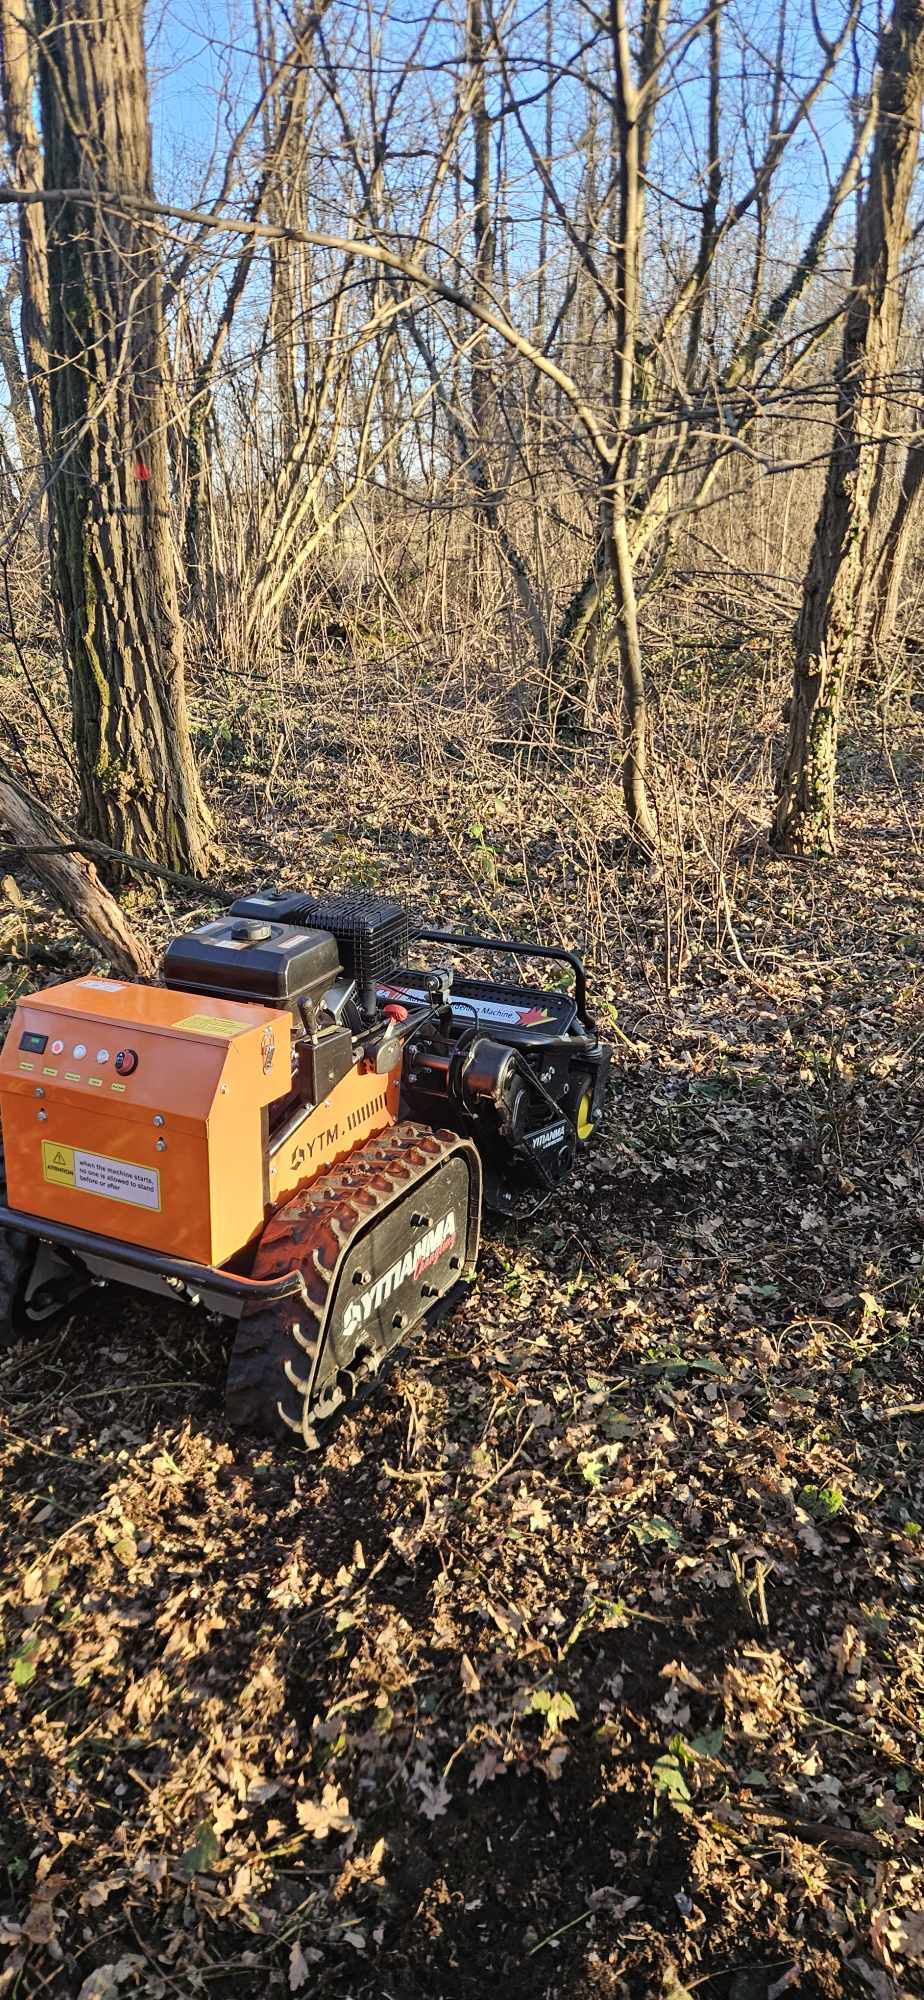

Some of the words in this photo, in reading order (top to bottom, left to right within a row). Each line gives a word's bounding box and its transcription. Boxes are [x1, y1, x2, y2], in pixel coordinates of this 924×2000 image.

[79, 1160, 95, 1169] when
[96, 1164, 106, 1173] the
[107, 1167, 133, 1179] machine
[79, 1175, 98, 1185] before
[106, 1182, 121, 1191] after
[88, 1170, 99, 1179] one
[107, 1175, 130, 1187] allowed
[137, 1184, 155, 1193] stand
